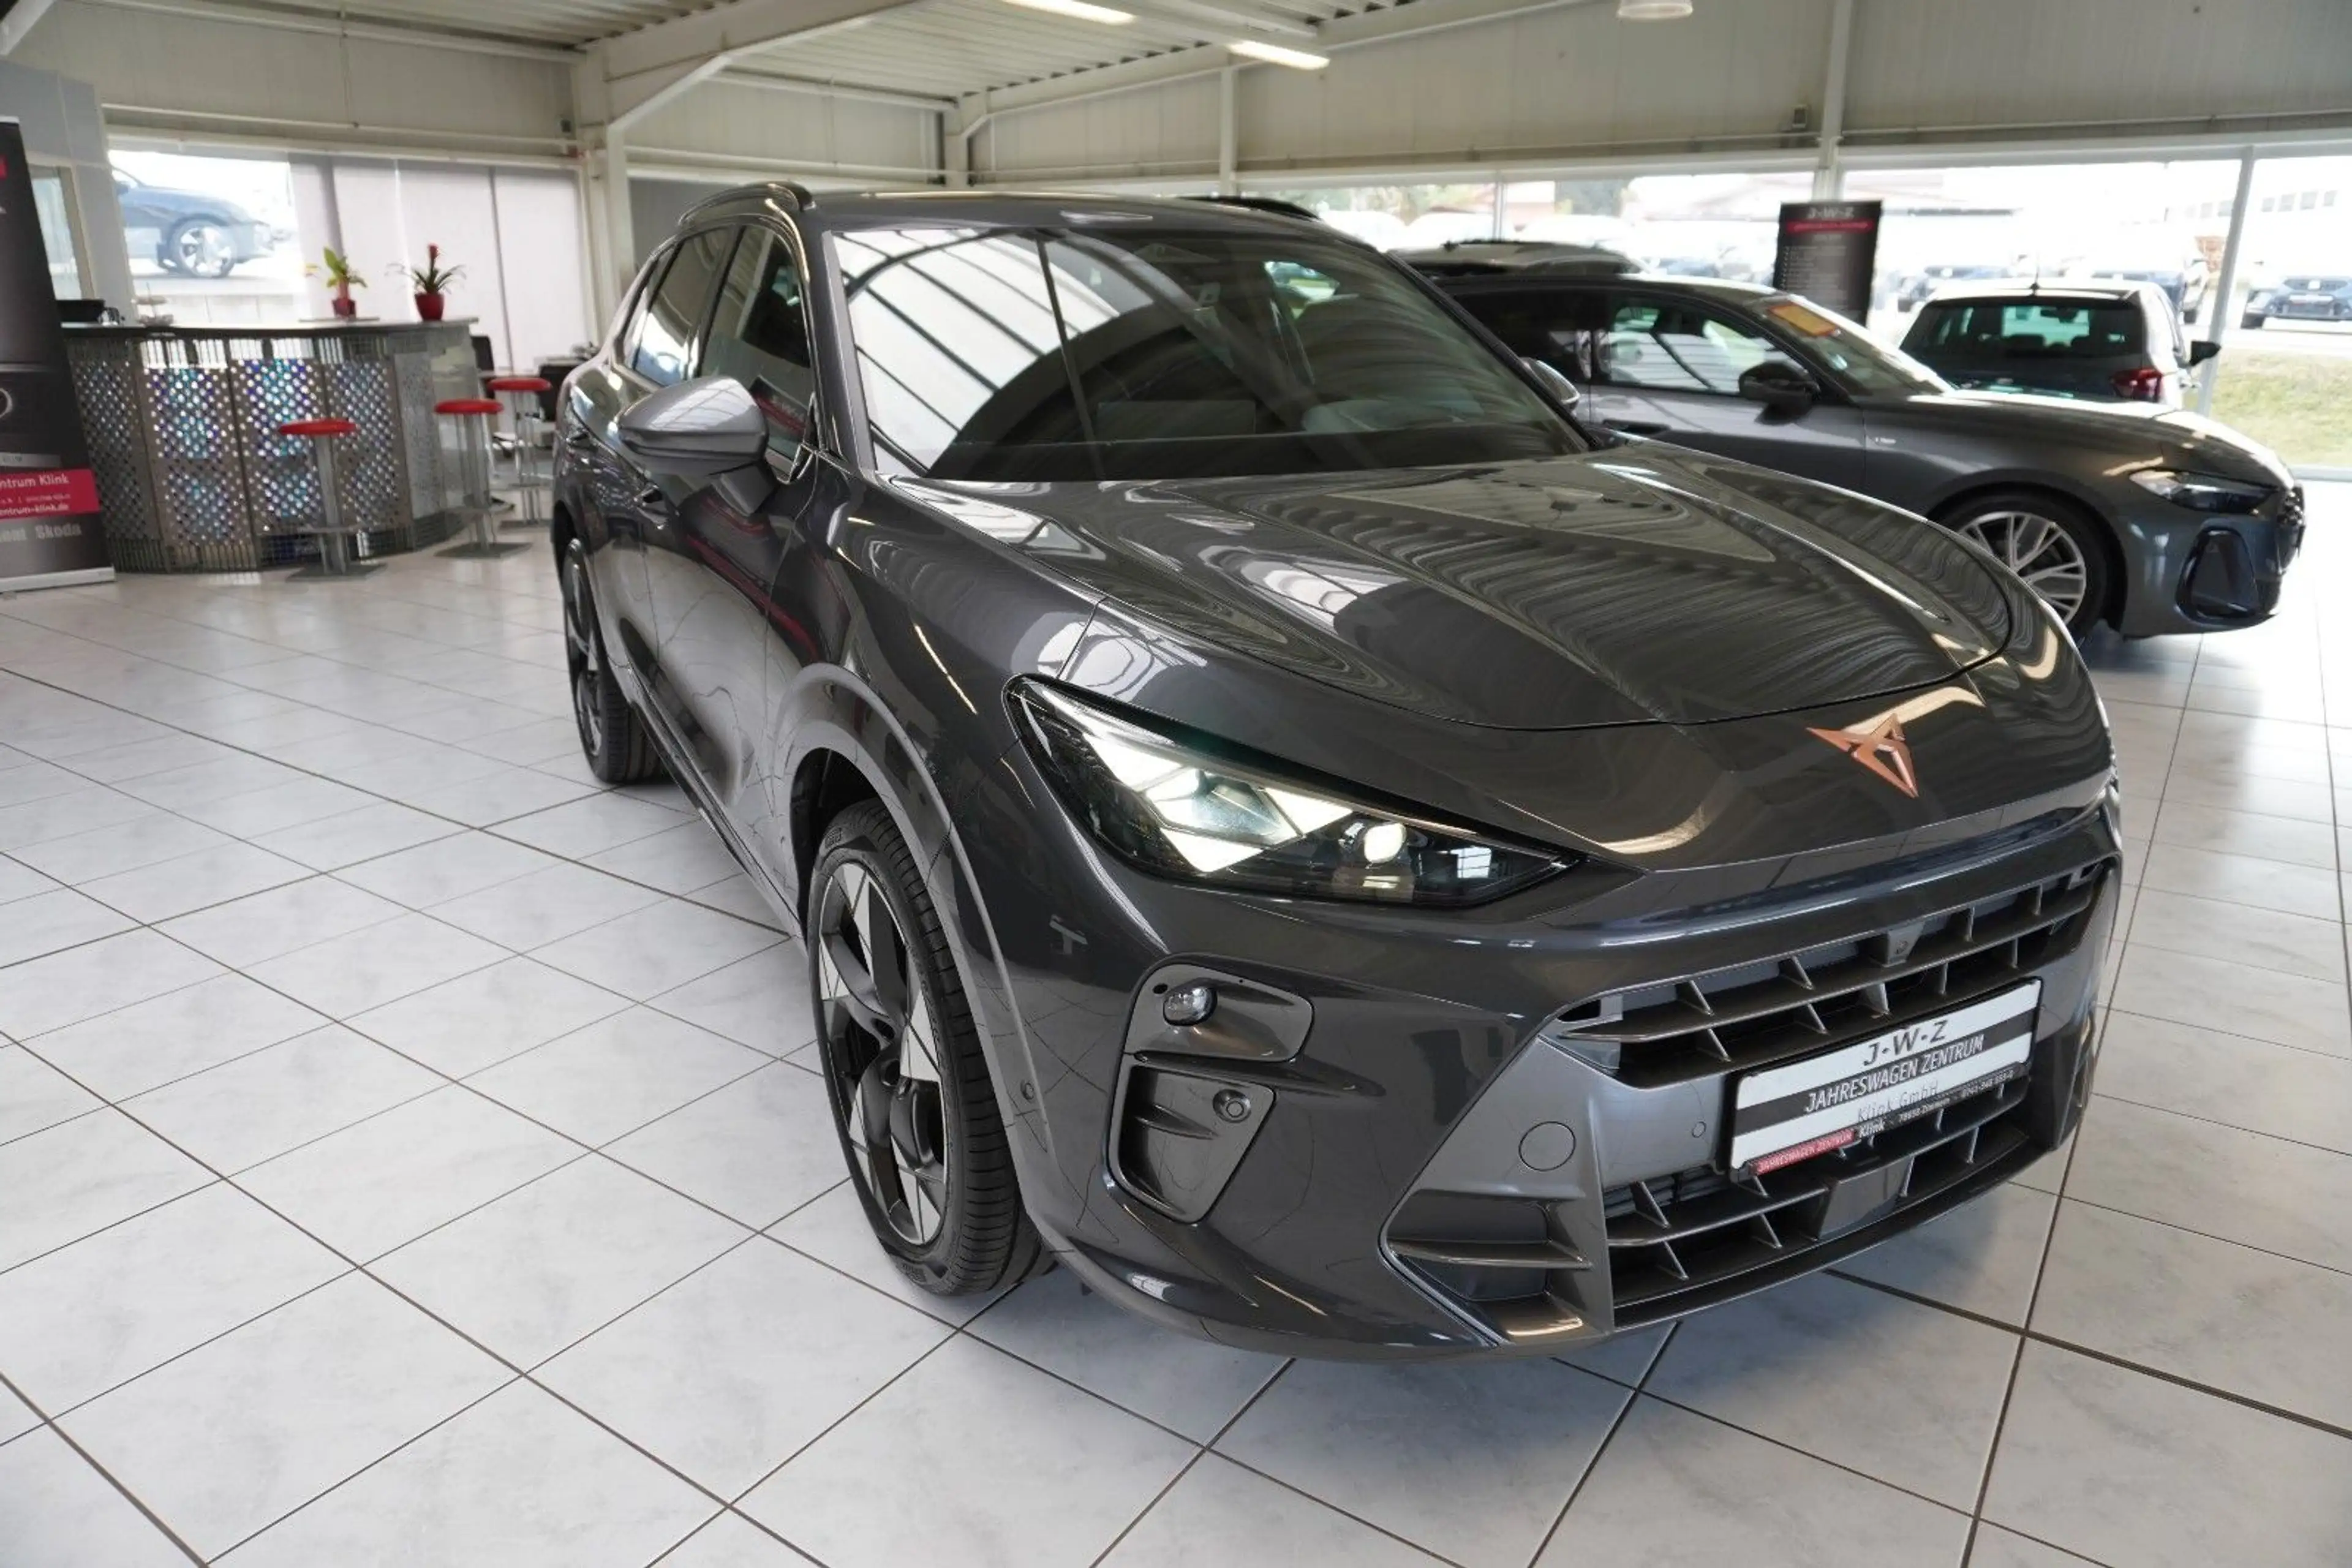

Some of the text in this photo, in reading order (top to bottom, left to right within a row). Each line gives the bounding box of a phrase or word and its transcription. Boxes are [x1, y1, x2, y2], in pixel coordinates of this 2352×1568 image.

[39, 472, 69, 485] Klink
[1804, 1058, 1919, 1112] JAHRESWAGEN
[1921, 1033, 1985, 1073] ZENTRUM
